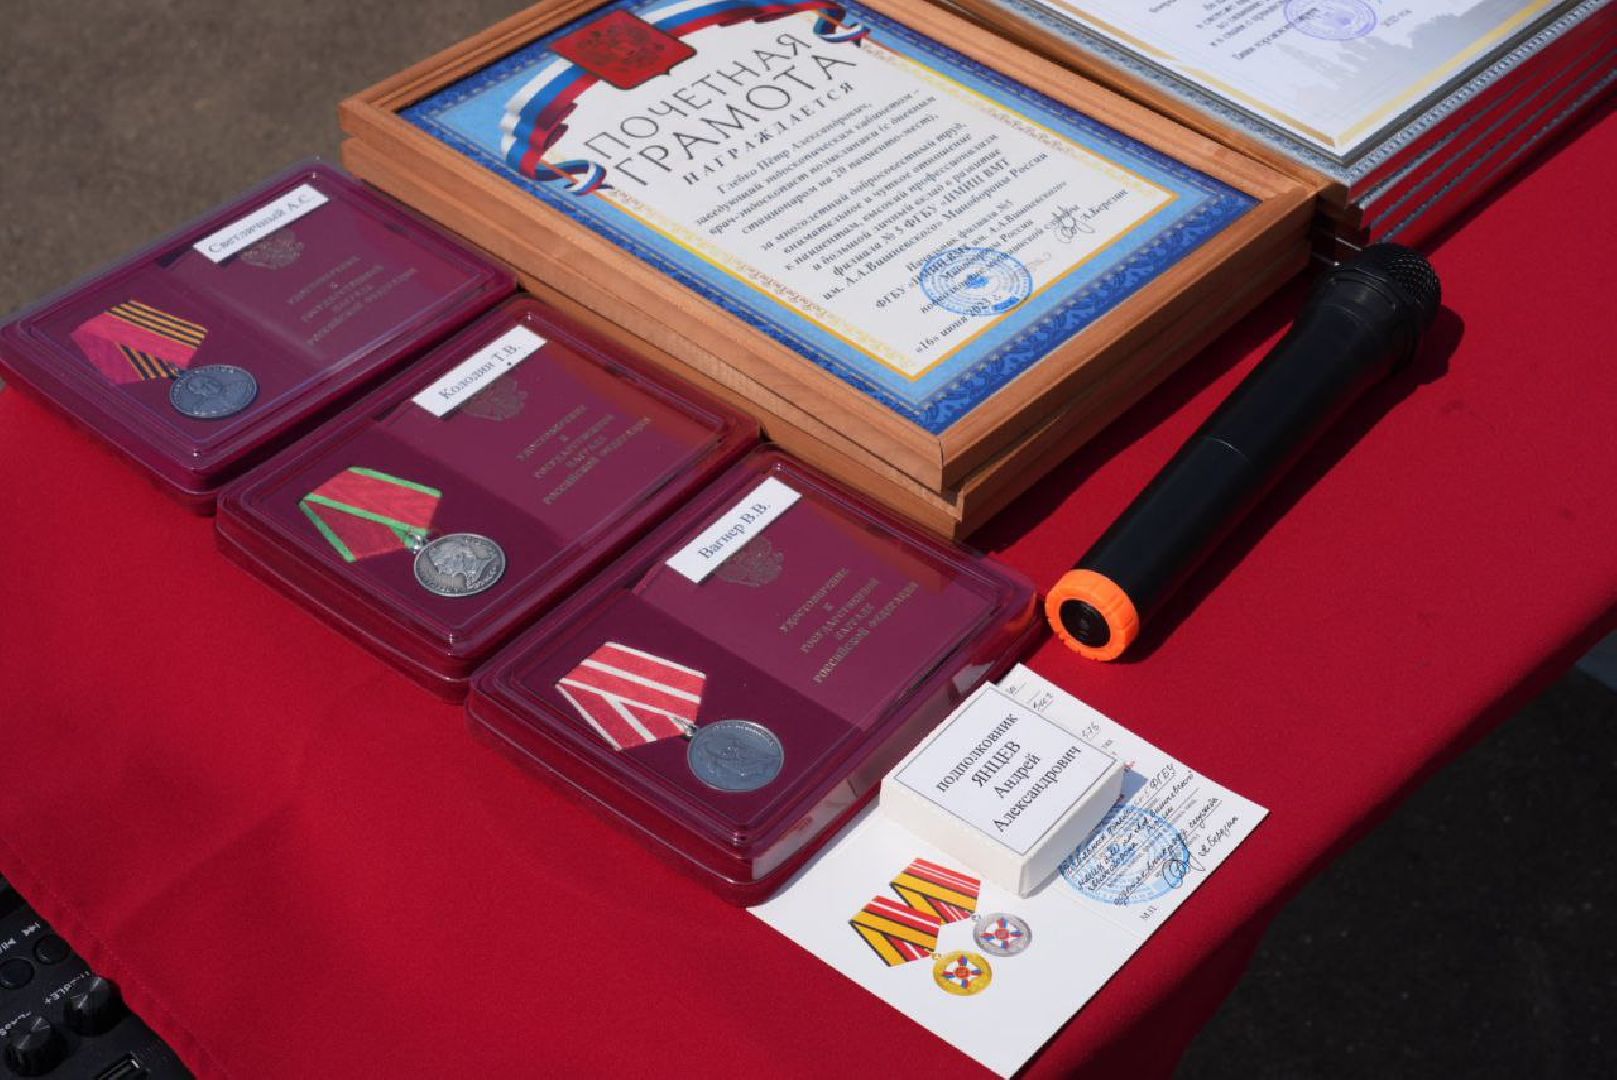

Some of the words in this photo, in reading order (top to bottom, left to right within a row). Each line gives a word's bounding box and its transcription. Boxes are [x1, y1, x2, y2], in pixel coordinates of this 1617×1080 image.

[584, 34, 812, 160] ПОЧЕТНАЯ
[614, 54, 857, 186] ГРАМОТА
[682, 81, 854, 185] НАГРАЖДАЕТСЯ
[698, 523, 746, 559] Вагнер
[739, 503, 772, 525] В.В.
[936, 712, 1019, 794] подполковник
[970, 740, 1022, 788] ЯНЦЕВ
[993, 745, 1083, 833] Александрович
[994, 751, 1042, 799] Андрей
